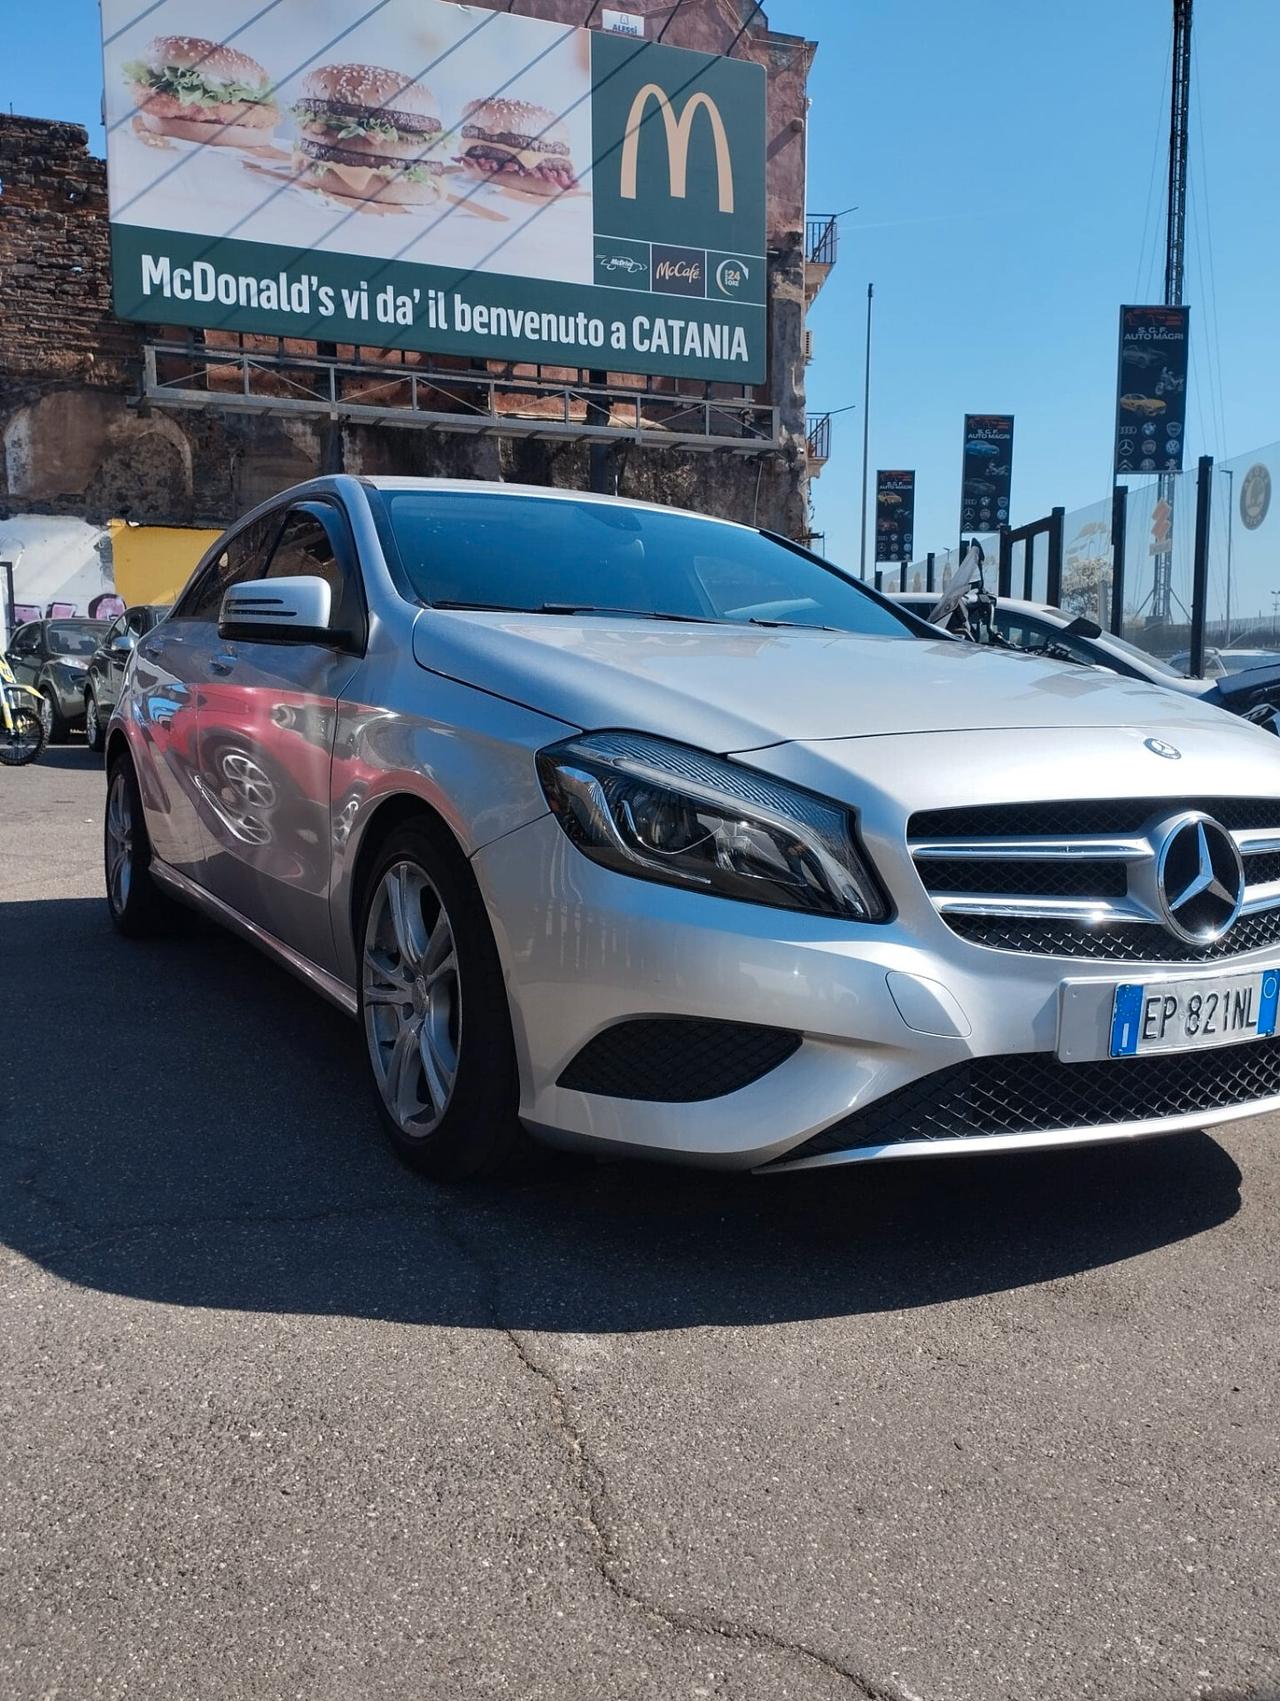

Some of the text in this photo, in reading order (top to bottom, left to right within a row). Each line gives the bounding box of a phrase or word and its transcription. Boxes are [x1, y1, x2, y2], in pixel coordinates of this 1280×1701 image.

[728, 270, 740, 280] 24
[141, 254, 749, 362] McDonald's vi da' il benvenuto a CATANIA
[1143, 995, 1178, 1040] EP
[1185, 986, 1258, 1037] 821NL
